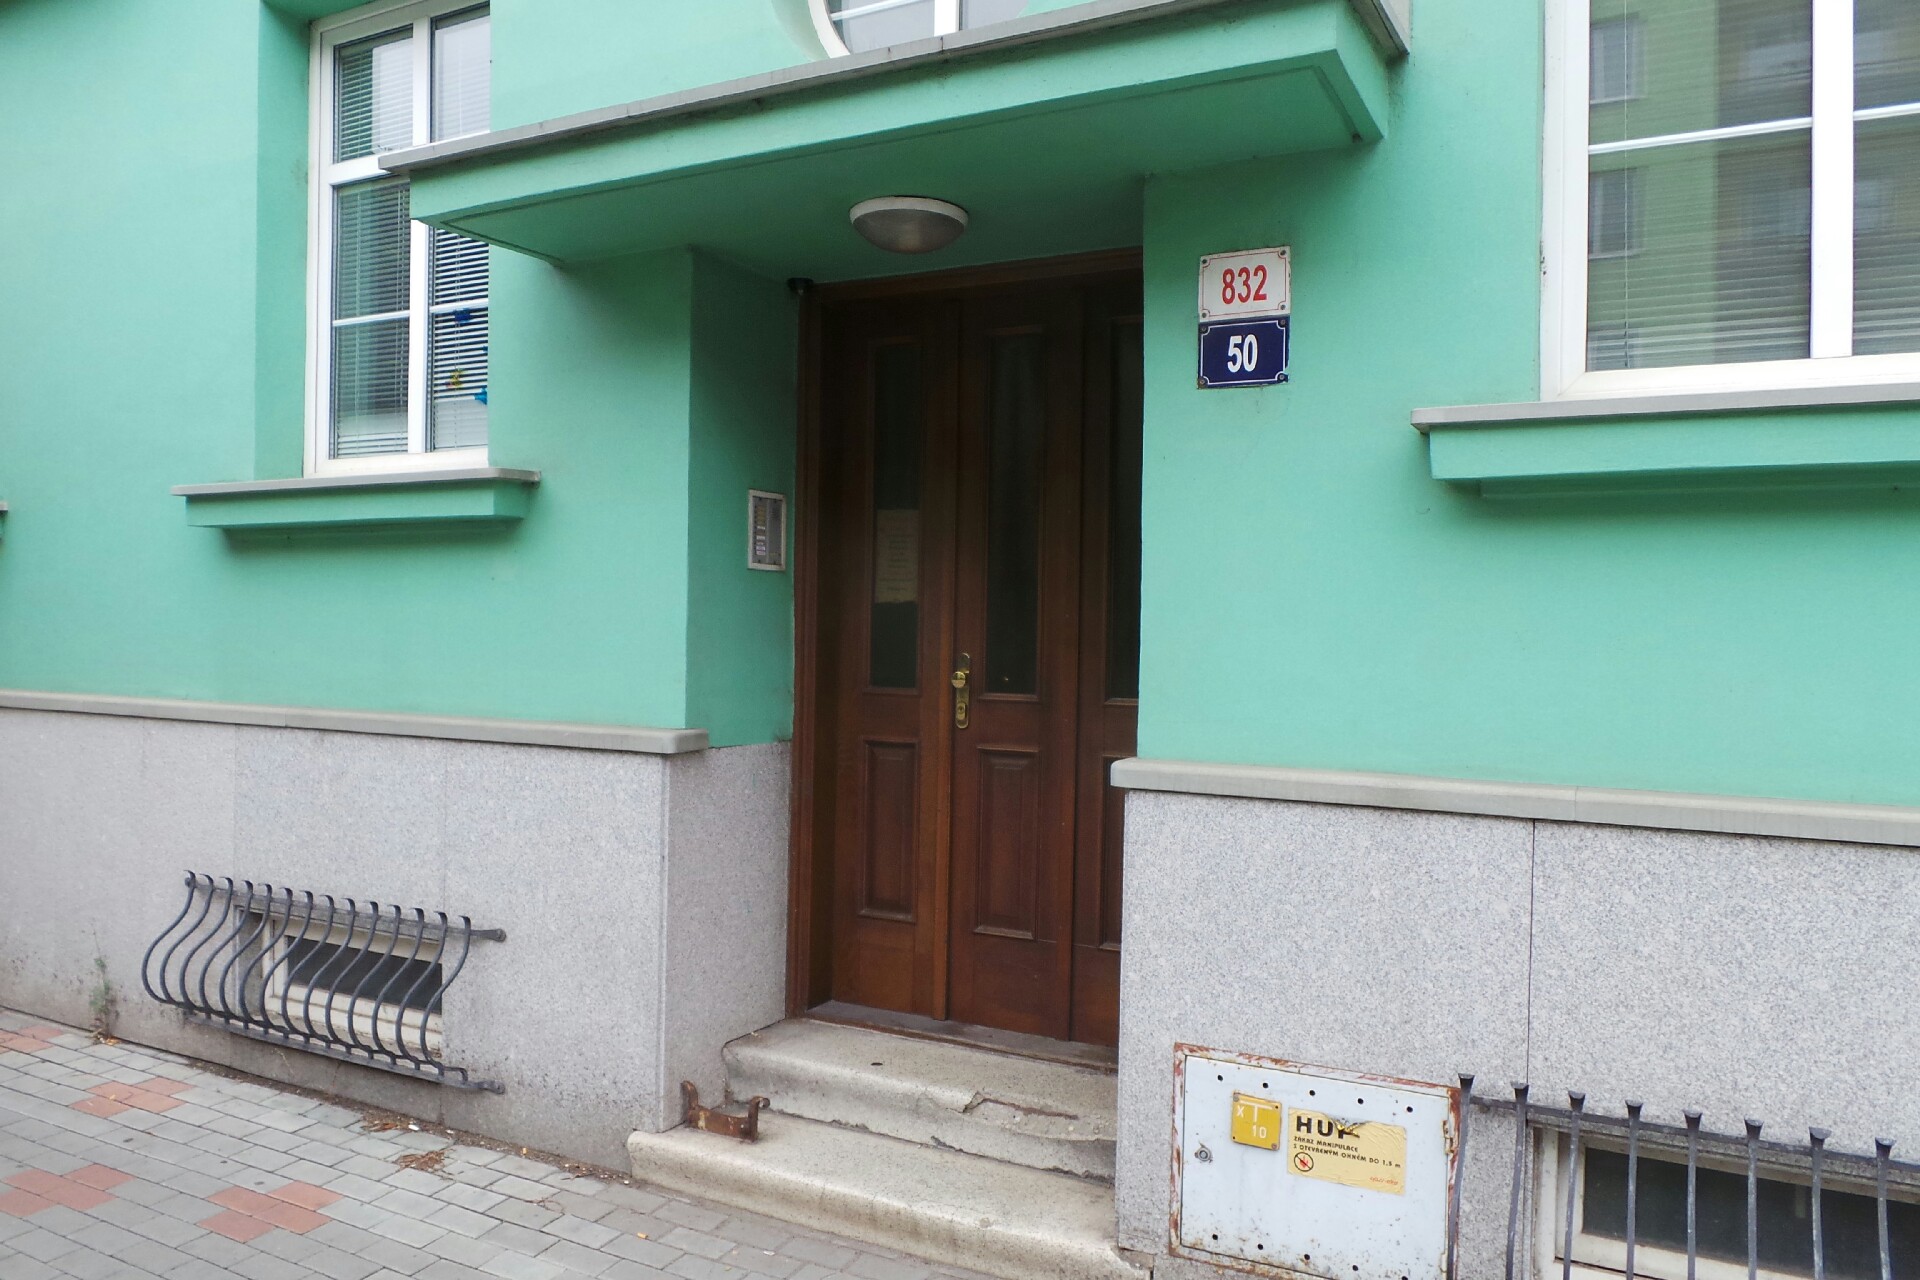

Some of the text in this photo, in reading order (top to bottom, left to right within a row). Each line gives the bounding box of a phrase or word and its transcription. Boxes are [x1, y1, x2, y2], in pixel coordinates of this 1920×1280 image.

[1222, 264, 1268, 305] 832
[1227, 334, 1258, 373] 50
[1252, 1124, 1267, 1139] 10
